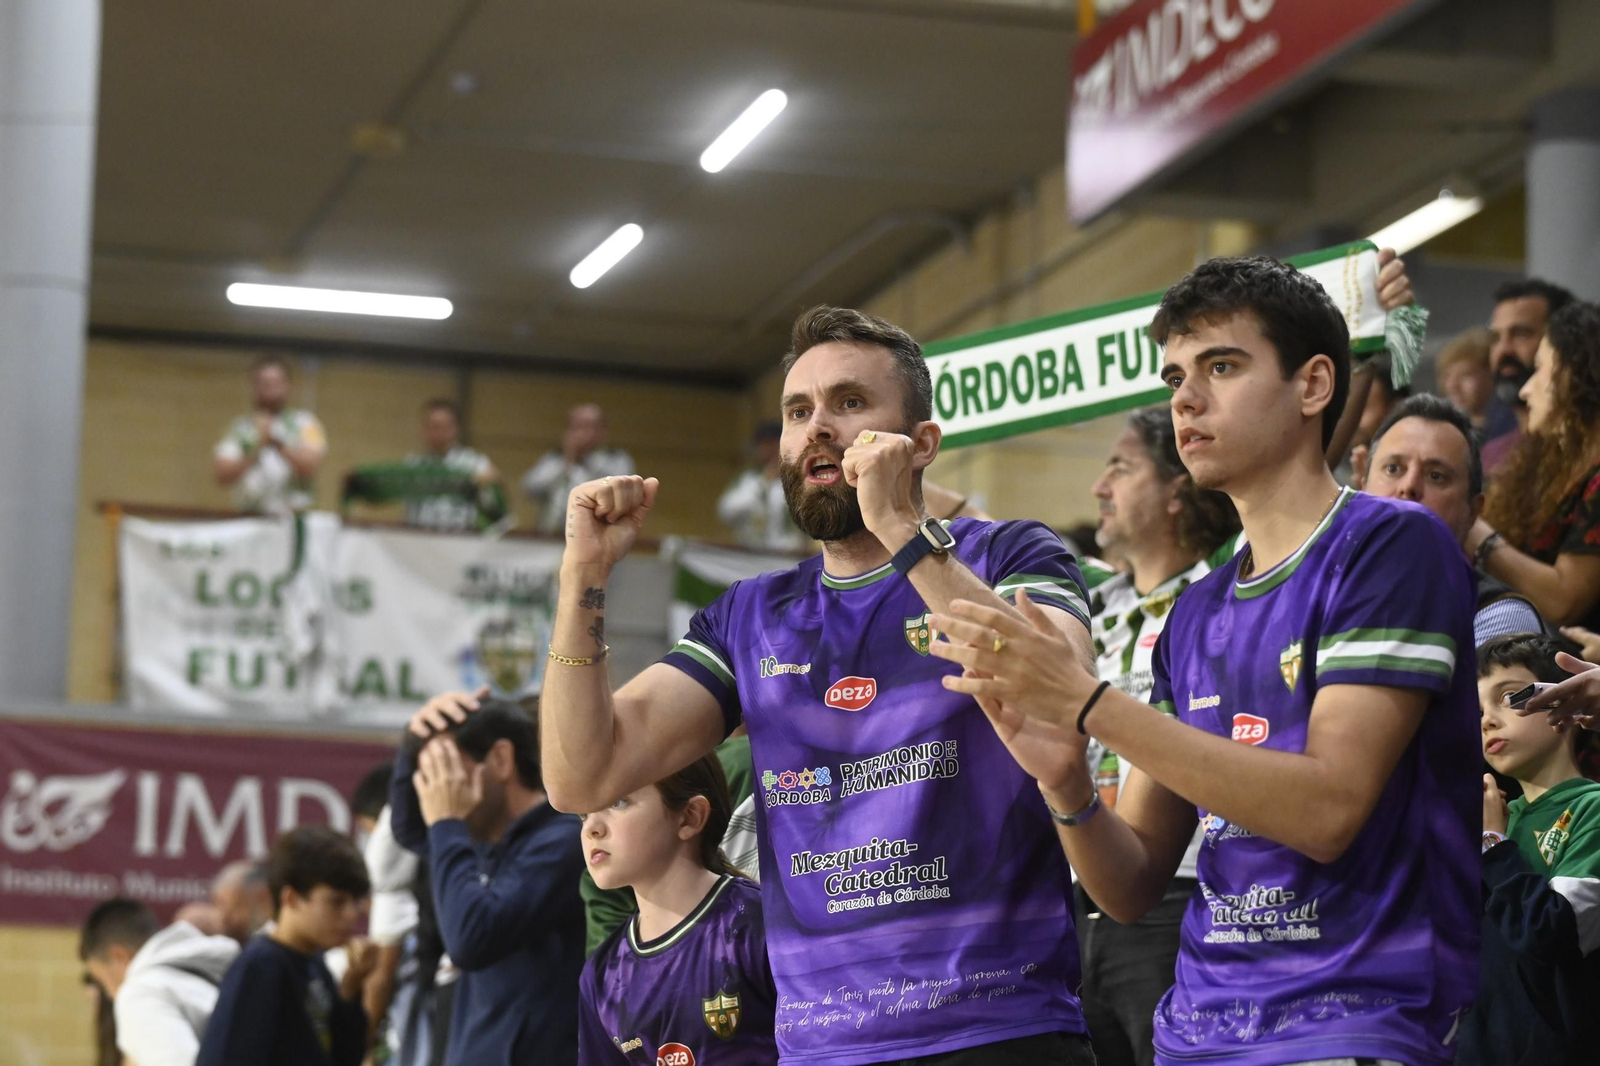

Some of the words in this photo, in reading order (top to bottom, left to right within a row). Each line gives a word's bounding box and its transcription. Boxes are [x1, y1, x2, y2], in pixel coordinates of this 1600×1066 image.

[934, 341, 1084, 421] ÓRDOBA
[1097, 325, 1158, 386] FUT
[1232, 724, 1264, 740] eza
[840, 742, 943, 779] PATRIMONIO
[945, 740, 957, 749] DE
[946, 748, 957, 757] LA
[841, 758, 958, 797] HUMANIDAD
[133, 770, 352, 859] IMD
[765, 788, 831, 808] CÓRDOBA
[791, 837, 917, 876] Mezquita-
[825, 856, 948, 896] Catedral
[827, 894, 874, 913] Corazón
[877, 891, 892, 905] de
[894, 884, 951, 901] Córdoba
